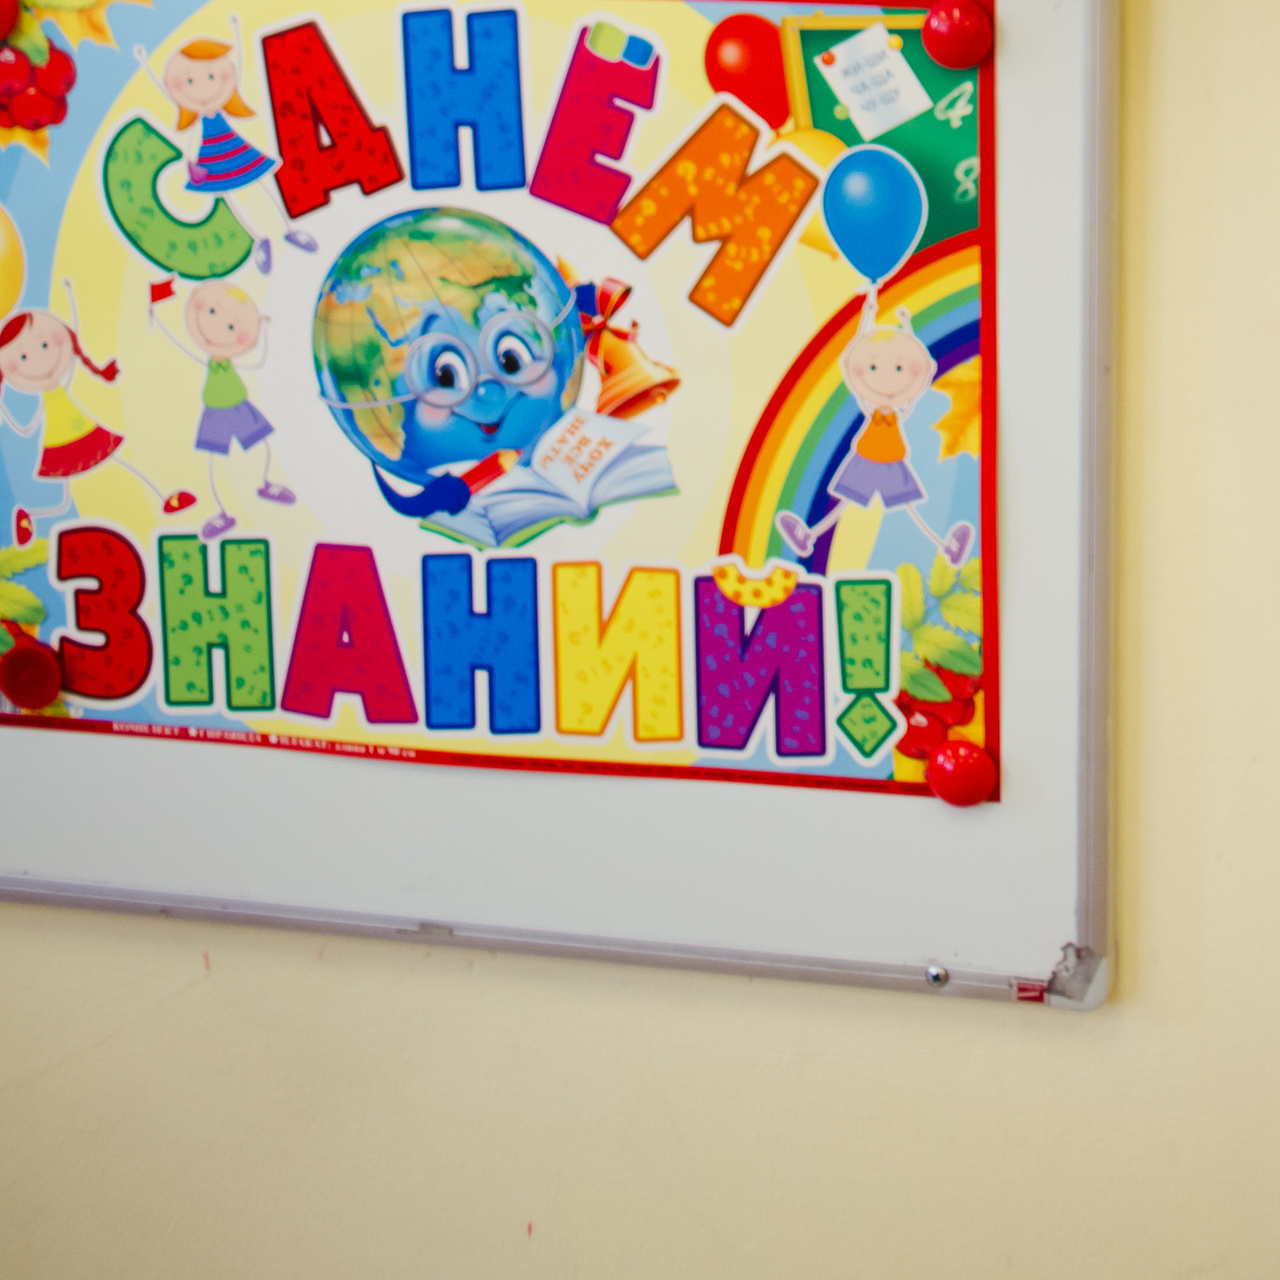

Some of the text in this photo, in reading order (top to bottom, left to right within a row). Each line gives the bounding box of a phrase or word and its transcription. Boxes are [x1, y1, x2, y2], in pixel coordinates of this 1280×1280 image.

[933, 80, 974, 129] 4
[102, 9, 820, 328] С ДНЕМ
[561, 435, 592, 467] ВСЕ
[573, 436, 614, 484] ХОЧУ
[55, 526, 899, 759] ЗНАНИЙ!
